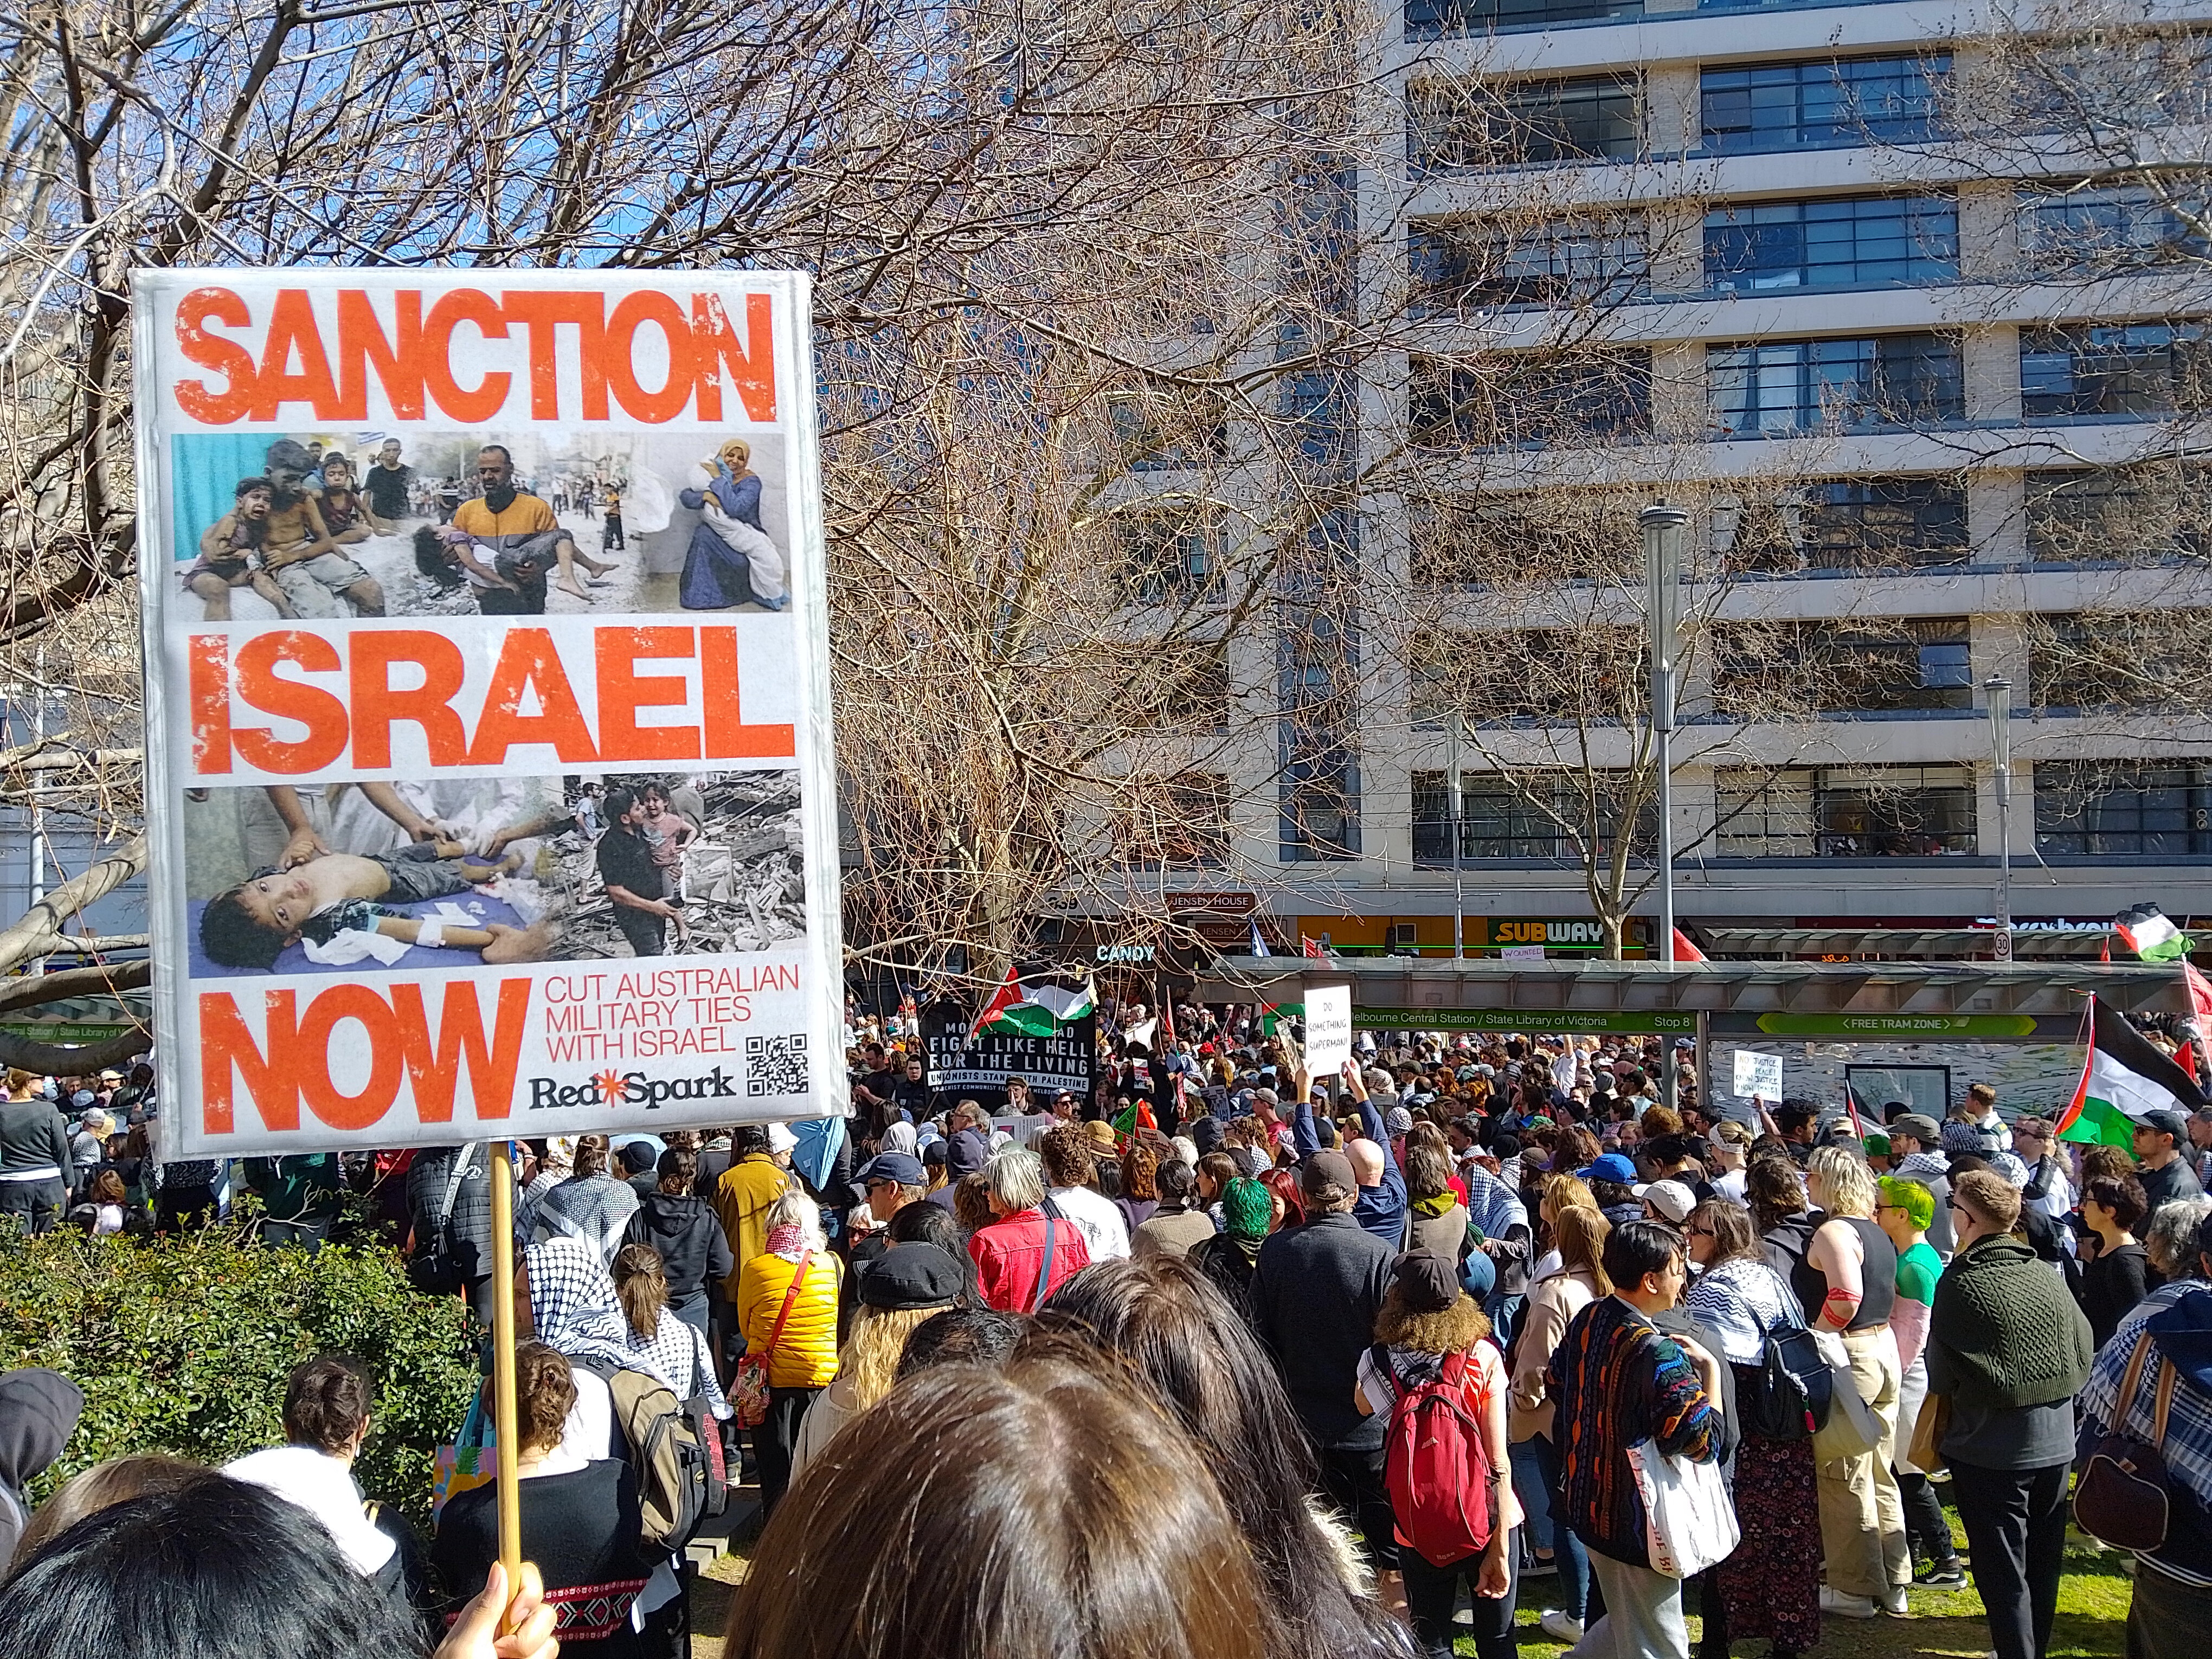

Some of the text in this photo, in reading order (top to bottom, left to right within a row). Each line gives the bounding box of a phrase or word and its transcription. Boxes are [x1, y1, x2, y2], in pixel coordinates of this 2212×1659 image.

[172, 288, 778, 425] SANCTION
[188, 626, 796, 775] ISRAEL
[1173, 897, 1249, 905] JENSEN HOUSE
[1495, 923, 1604, 942] SUBWAY
[1997, 939, 2008, 950] 30
[1097, 946, 1155, 961] CANDY
[545, 964, 799, 1004] CUT AUSTRALIAN
[546, 995, 751, 1033] MILITARY TIES
[1323, 1002, 1332, 1012] DO
[1308, 1019, 1347, 1033] SOMETHING
[1400, 1013, 1437, 1023] Central
[1439, 1014, 1476, 1024] Station
[1486, 1014, 1513, 1024] State
[1516, 1015, 1551, 1027] Library
[1554, 1015, 1566, 1025] of
[1567, 1015, 1607, 1026] Victoria
[1654, 1017, 1690, 1028] Stop 8
[1851, 1019, 1941, 1028] FREE TRAM ZONE
[28, 1027, 53, 1036] Station
[60, 1027, 80, 1037] State
[81, 1028, 107, 1039] Library
[109, 1028, 117, 1037] of
[546, 1026, 736, 1063] WITH ISRAEL
[995, 1038, 1036, 1053] LIKE
[1046, 1040, 1088, 1057] HELL
[198, 977, 532, 1135] NOW
[929, 1053, 1088, 1075] FOR THE LIVING
[1739, 1055, 1779, 1068] NO JUSTICE,
[931, 1071, 979, 1082] UNIONISTS
[1041, 1076, 1086, 1089] PALESTINE
[1756, 1068, 1776, 1076] PEACE!
[528, 1066, 737, 1110] Red Spark
